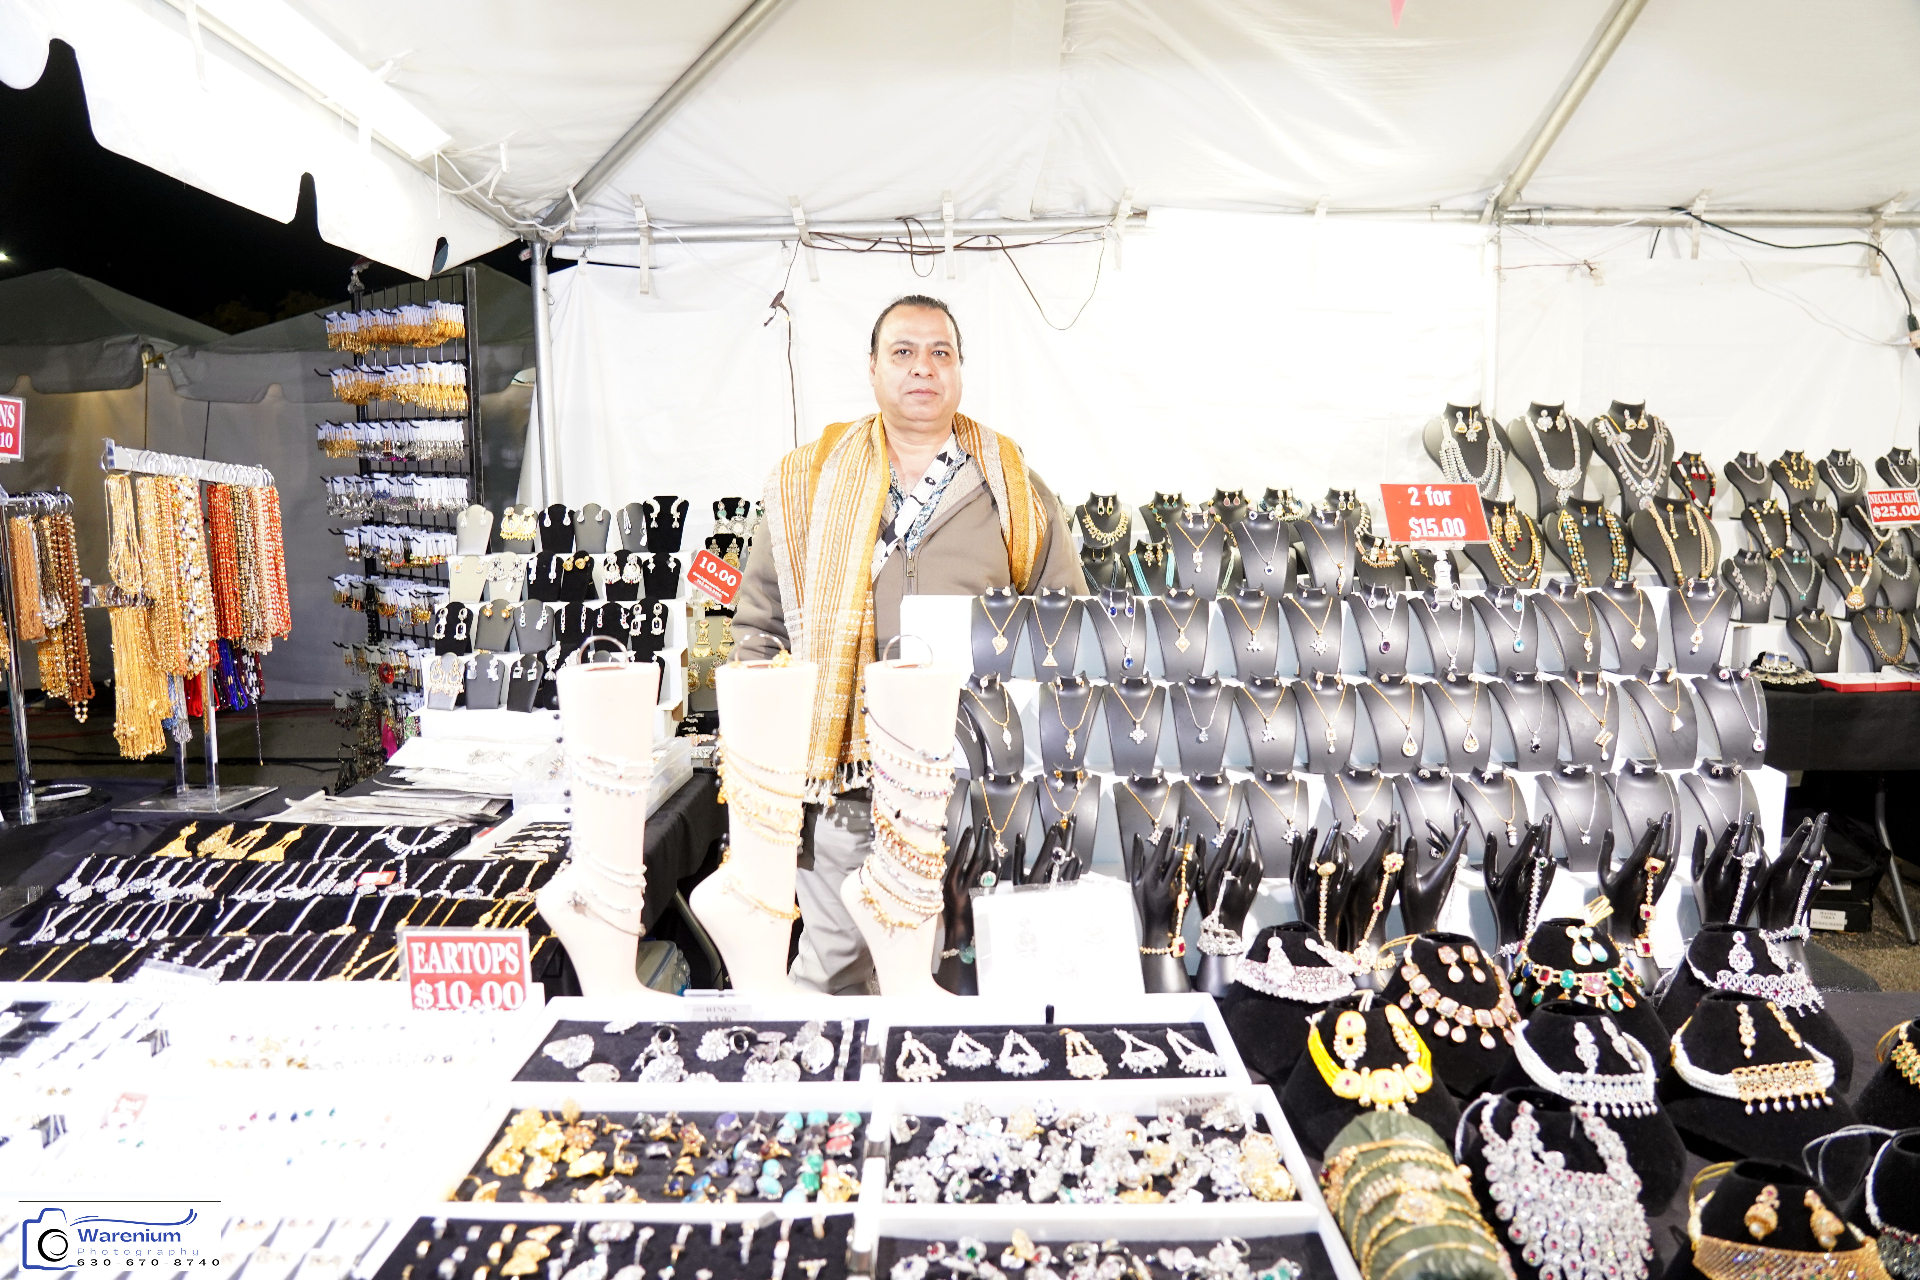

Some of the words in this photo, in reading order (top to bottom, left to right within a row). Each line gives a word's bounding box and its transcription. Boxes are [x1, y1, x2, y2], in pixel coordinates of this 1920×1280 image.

[1408, 487, 1421, 506] 2
[1425, 486, 1452, 506] for
[1869, 493, 1904, 505] NECKLACE
[1904, 492, 1917, 503] SET
[1872, 504, 1920, 519] $25.00
[1409, 517, 1466, 538] $15.00
[699, 556, 737, 587] 10.00
[410, 942, 520, 975] EARTOPS
[413, 979, 524, 1010] $10.00
